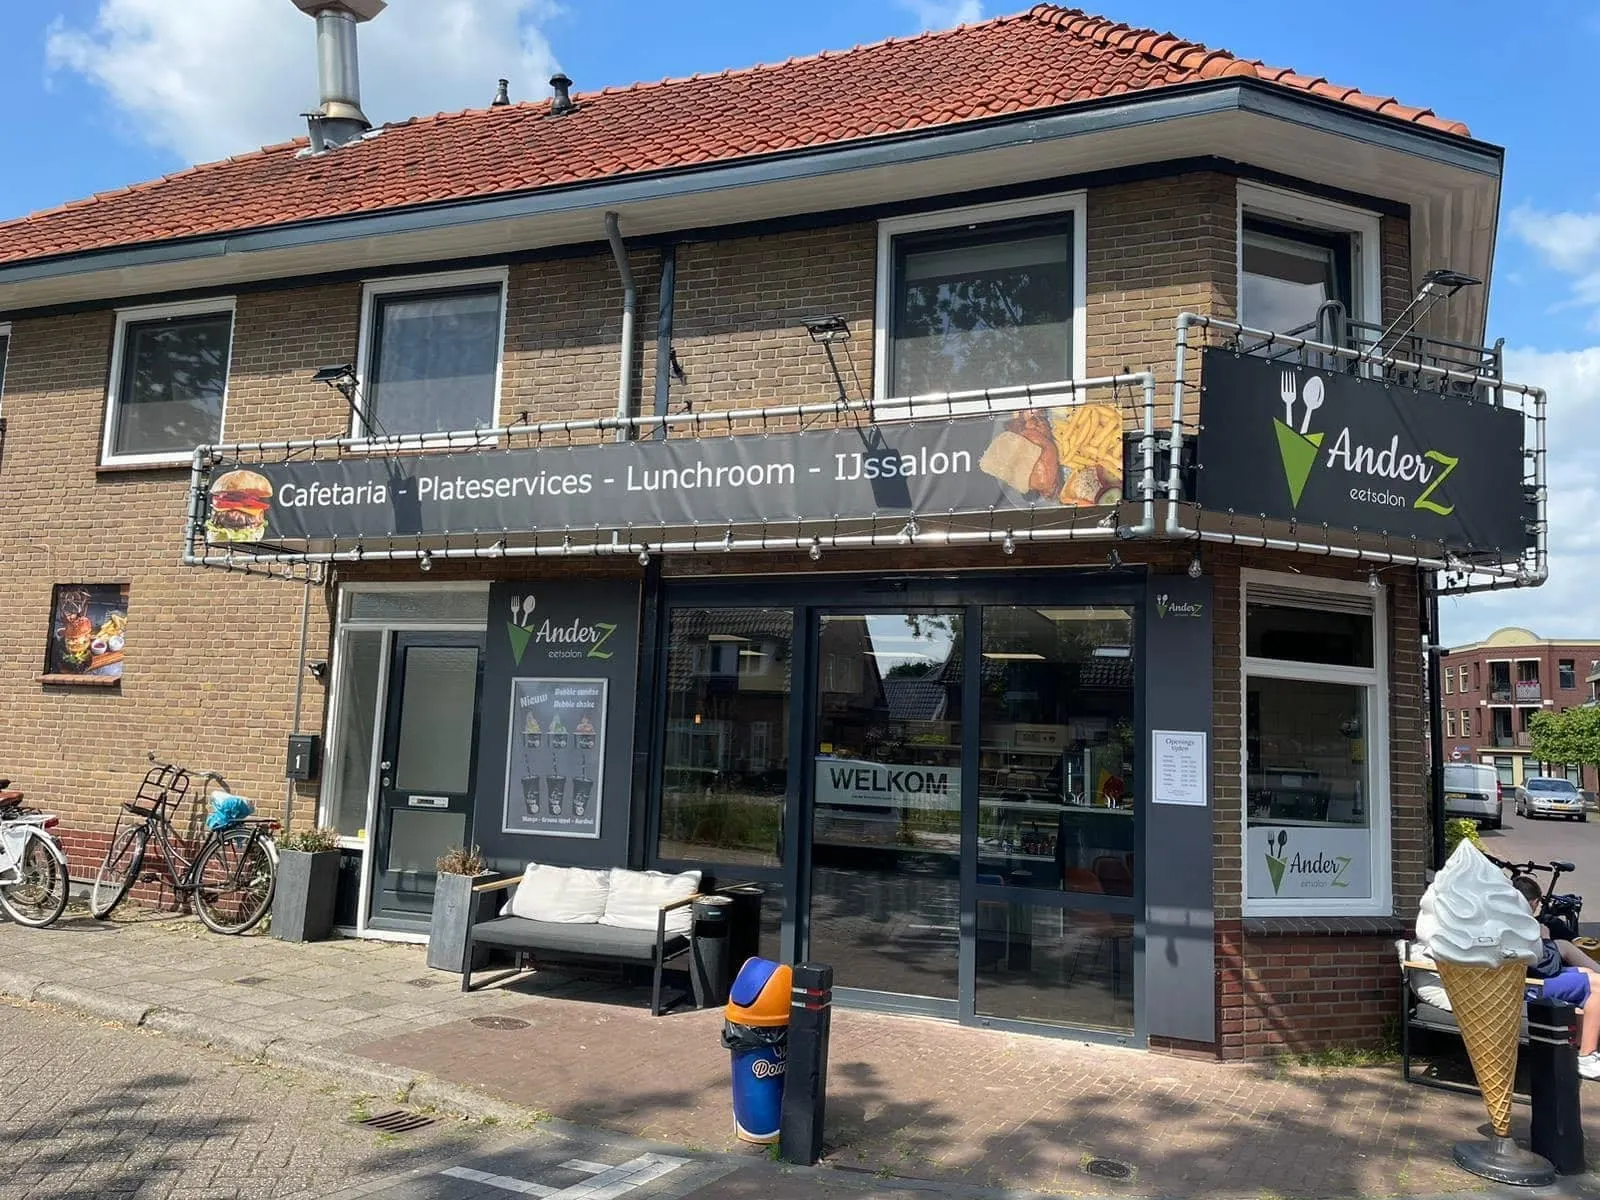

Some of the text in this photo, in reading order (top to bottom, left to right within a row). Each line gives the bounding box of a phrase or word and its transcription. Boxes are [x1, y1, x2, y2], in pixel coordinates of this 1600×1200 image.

[278, 480, 387, 508] Cafetaria
[418, 470, 593, 502] Plateservices
[627, 461, 796, 492] Lunchroom
[834, 446, 971, 481] IJssalon
[1326, 426, 1459, 516] AnderZ
[1349, 487, 1406, 508] eetsalon
[535, 618, 618, 659] AnderZ
[295, 755, 301, 769] 1
[830, 767, 948, 795] WELKOM
[1289, 851, 1352, 888] AnderZ
